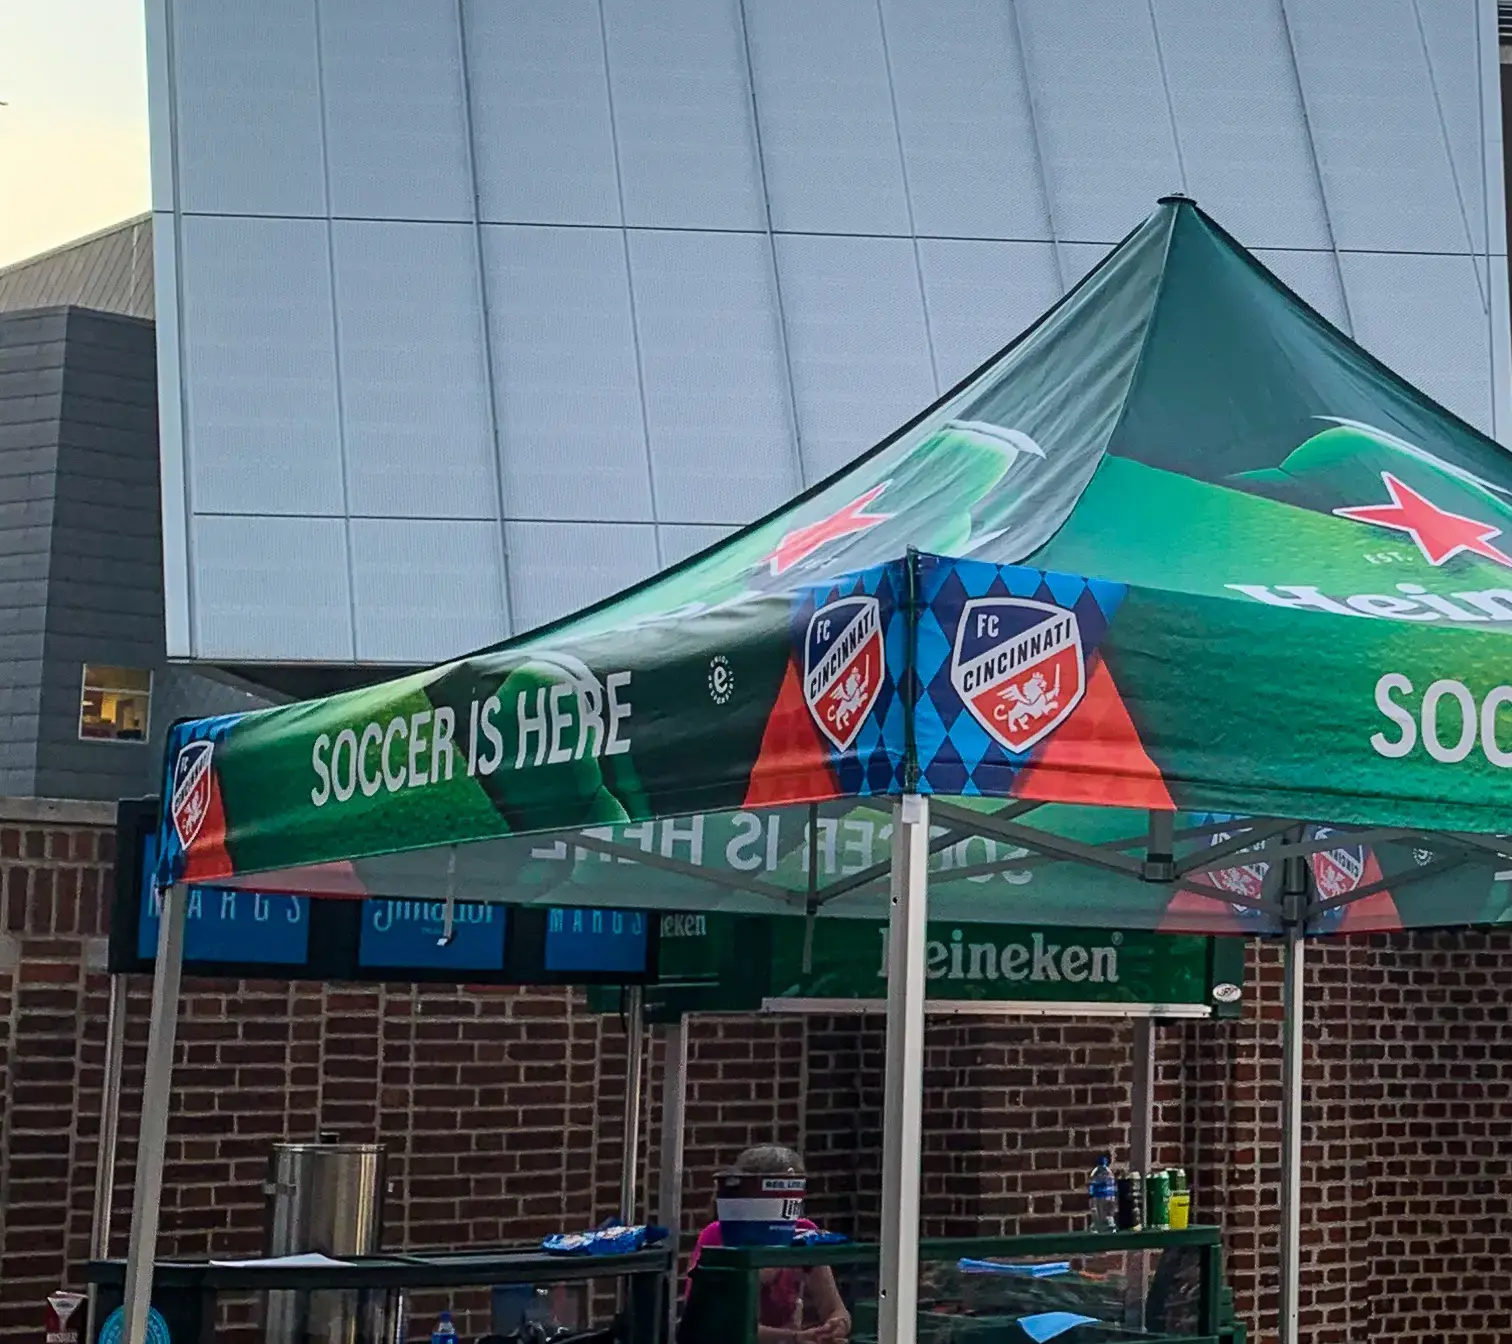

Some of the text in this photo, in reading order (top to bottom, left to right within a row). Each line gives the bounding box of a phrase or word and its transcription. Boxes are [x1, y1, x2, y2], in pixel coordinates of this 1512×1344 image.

[809, 606, 875, 701] CINCINNATI
[816, 618, 831, 645] FC
[962, 618, 1071, 693] CINCINNATI
[976, 613, 999, 639] FC
[311, 706, 456, 807] SOCCER
[467, 696, 501, 777] IS
[515, 671, 632, 770] HERE
